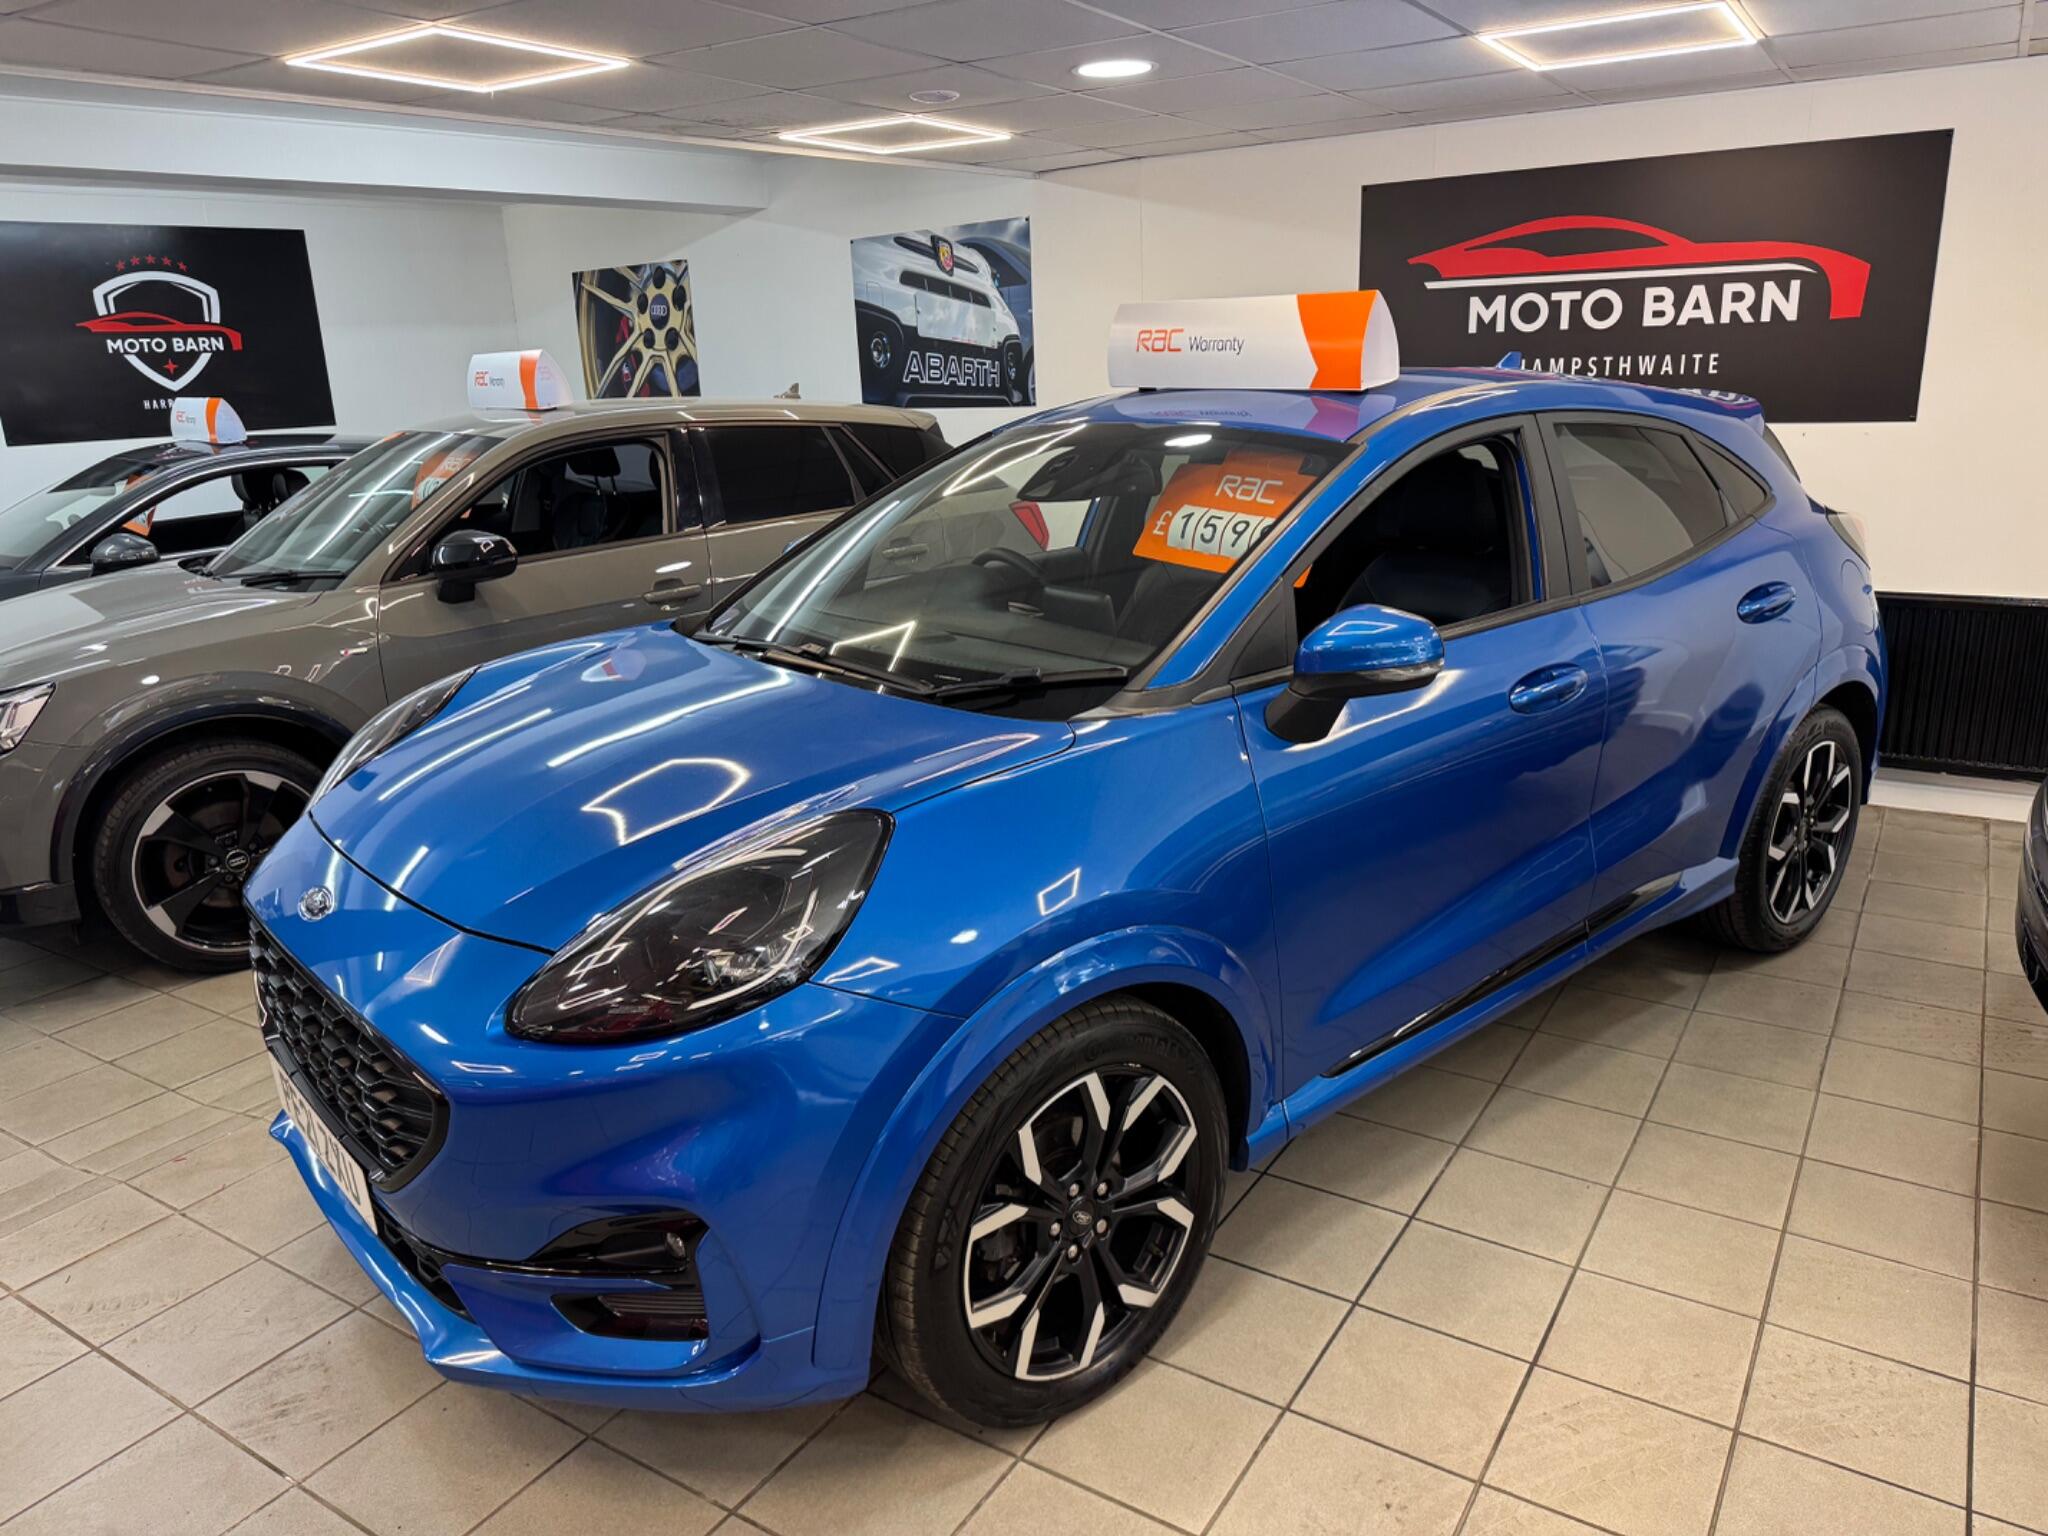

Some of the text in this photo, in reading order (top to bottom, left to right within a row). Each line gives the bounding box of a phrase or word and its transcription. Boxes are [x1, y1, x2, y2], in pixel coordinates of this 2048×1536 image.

[1468, 279, 1801, 334] MOTO BARN
[106, 336, 225, 354] MOTO BARN
[1136, 328, 1245, 355] RAC Warranty
[903, 350, 1000, 387] ABARTH
[1216, 474, 1283, 505] RAC
